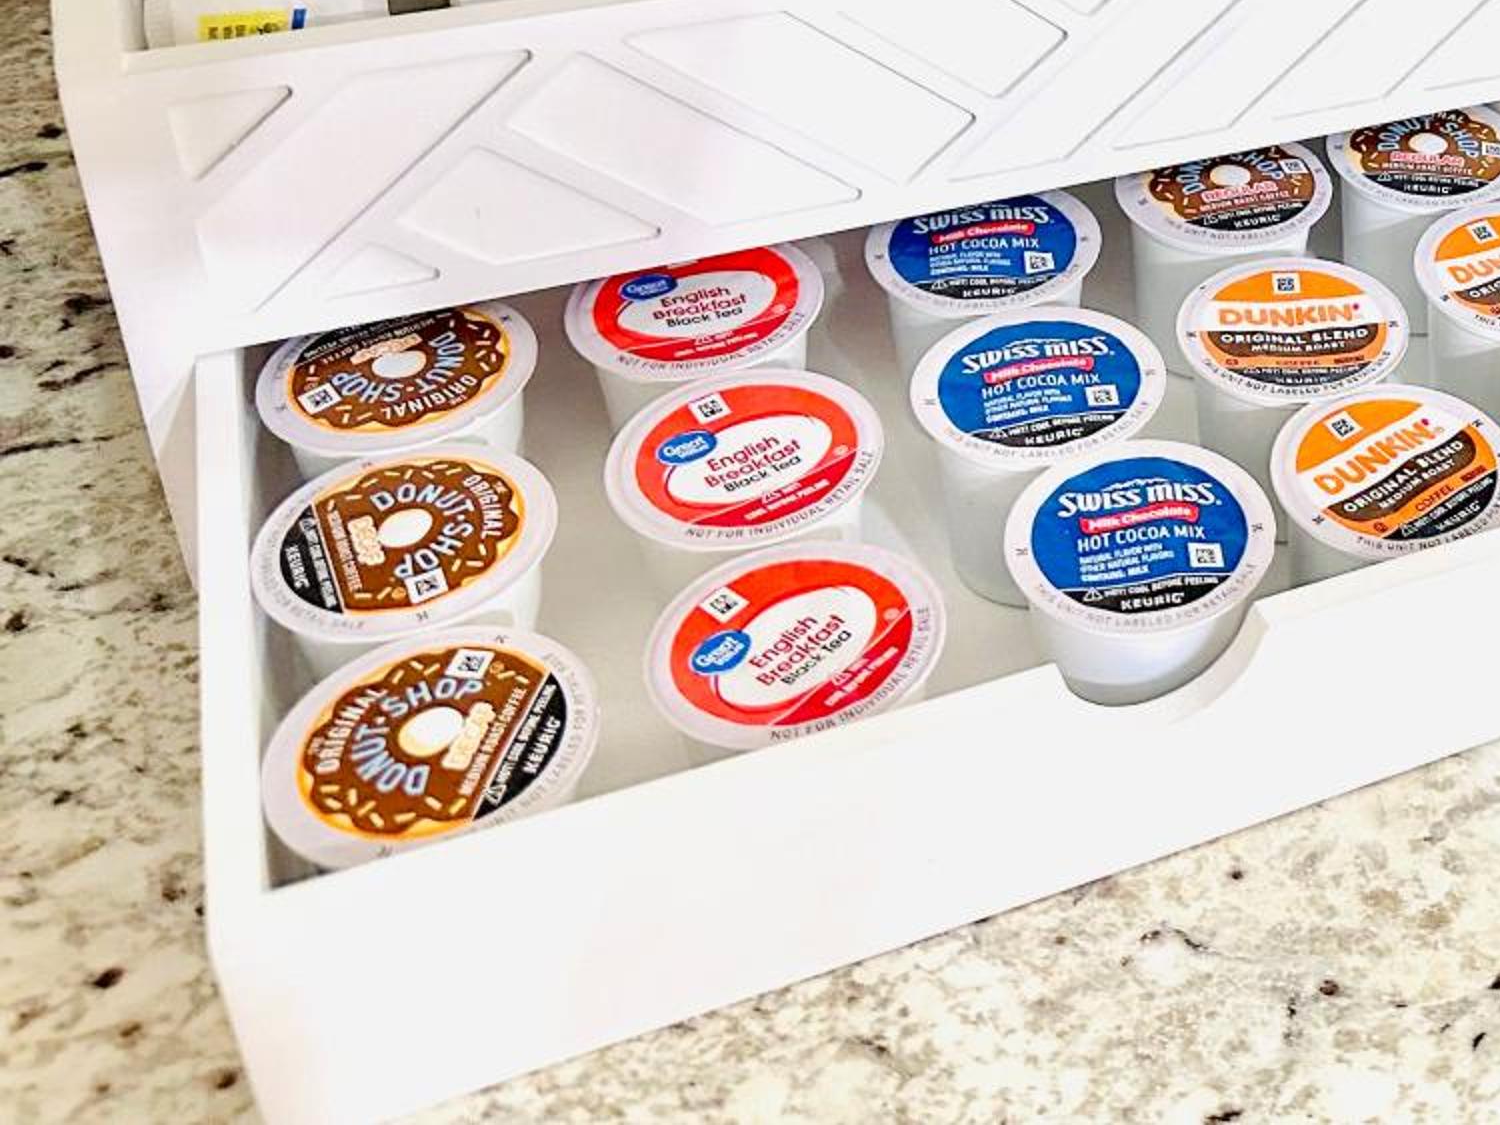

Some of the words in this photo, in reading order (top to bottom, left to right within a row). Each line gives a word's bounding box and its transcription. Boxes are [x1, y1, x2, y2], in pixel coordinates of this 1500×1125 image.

[1439, 122, 1480, 158] SHOP
[928, 243, 956, 256] HOT
[961, 239, 1009, 250] COCOA
[1012, 237, 1040, 248] MIX
[651, 293, 747, 321] Breakfast
[660, 285, 731, 309] English
[1217, 302, 1360, 326] DUNKIN'
[666, 313, 711, 328] Black
[715, 306, 743, 320] Tea
[1220, 333, 1306, 345] ORIGINAL
[1313, 327, 1369, 340] BLEND
[417, 330, 465, 392] DONUT
[616, 354, 637, 367] NOT
[640, 359, 667, 370] FOR
[670, 353, 746, 370] INDIVIDUAL
[330, 371, 405, 404] SHOP
[381, 375, 478, 420] ORIGINAL
[981, 380, 1014, 399] HOT
[1018, 373, 1068, 391] COCOA
[1071, 373, 1101, 385] MIX
[706, 436, 781, 472] English
[1024, 427, 1083, 445] KEURIG
[703, 440, 802, 488] Breakfast
[723, 473, 769, 492] Black
[773, 456, 802, 474] Tea
[1313, 418, 1437, 496] DUNKIN'
[1343, 468, 1418, 513] ORIGINAL
[1421, 440, 1465, 469] BLEND
[1379, 480, 1423, 509] MEDIUM
[368, 482, 477, 514] DONUT
[462, 474, 505, 539] ORIGINAL
[686, 528, 712, 539] NOT
[716, 529, 745, 539] FOR
[749, 505, 824, 536] INDIVIDUAL
[1087, 515, 1121, 530] Milk
[1122, 505, 1192, 524] Chocolate
[393, 522, 474, 581] SHOP
[1077, 532, 1111, 552] HOT
[1115, 526, 1171, 544] COCOA
[1174, 526, 1206, 540] MIX
[1120, 593, 1185, 611] KEURIG
[750, 616, 818, 669] English
[756, 614, 846, 687] Breakfast
[780, 654, 824, 686] Black
[822, 630, 852, 654] Tea
[380, 677, 484, 719] SHOP
[771, 728, 800, 741] NOT
[804, 718, 836, 735] FOR
[838, 679, 904, 726] INDIVIDUAL
[316, 688, 388, 773] ORIGINAL
[523, 717, 563, 775] KEURIG
[349, 723, 431, 796] DONUT
